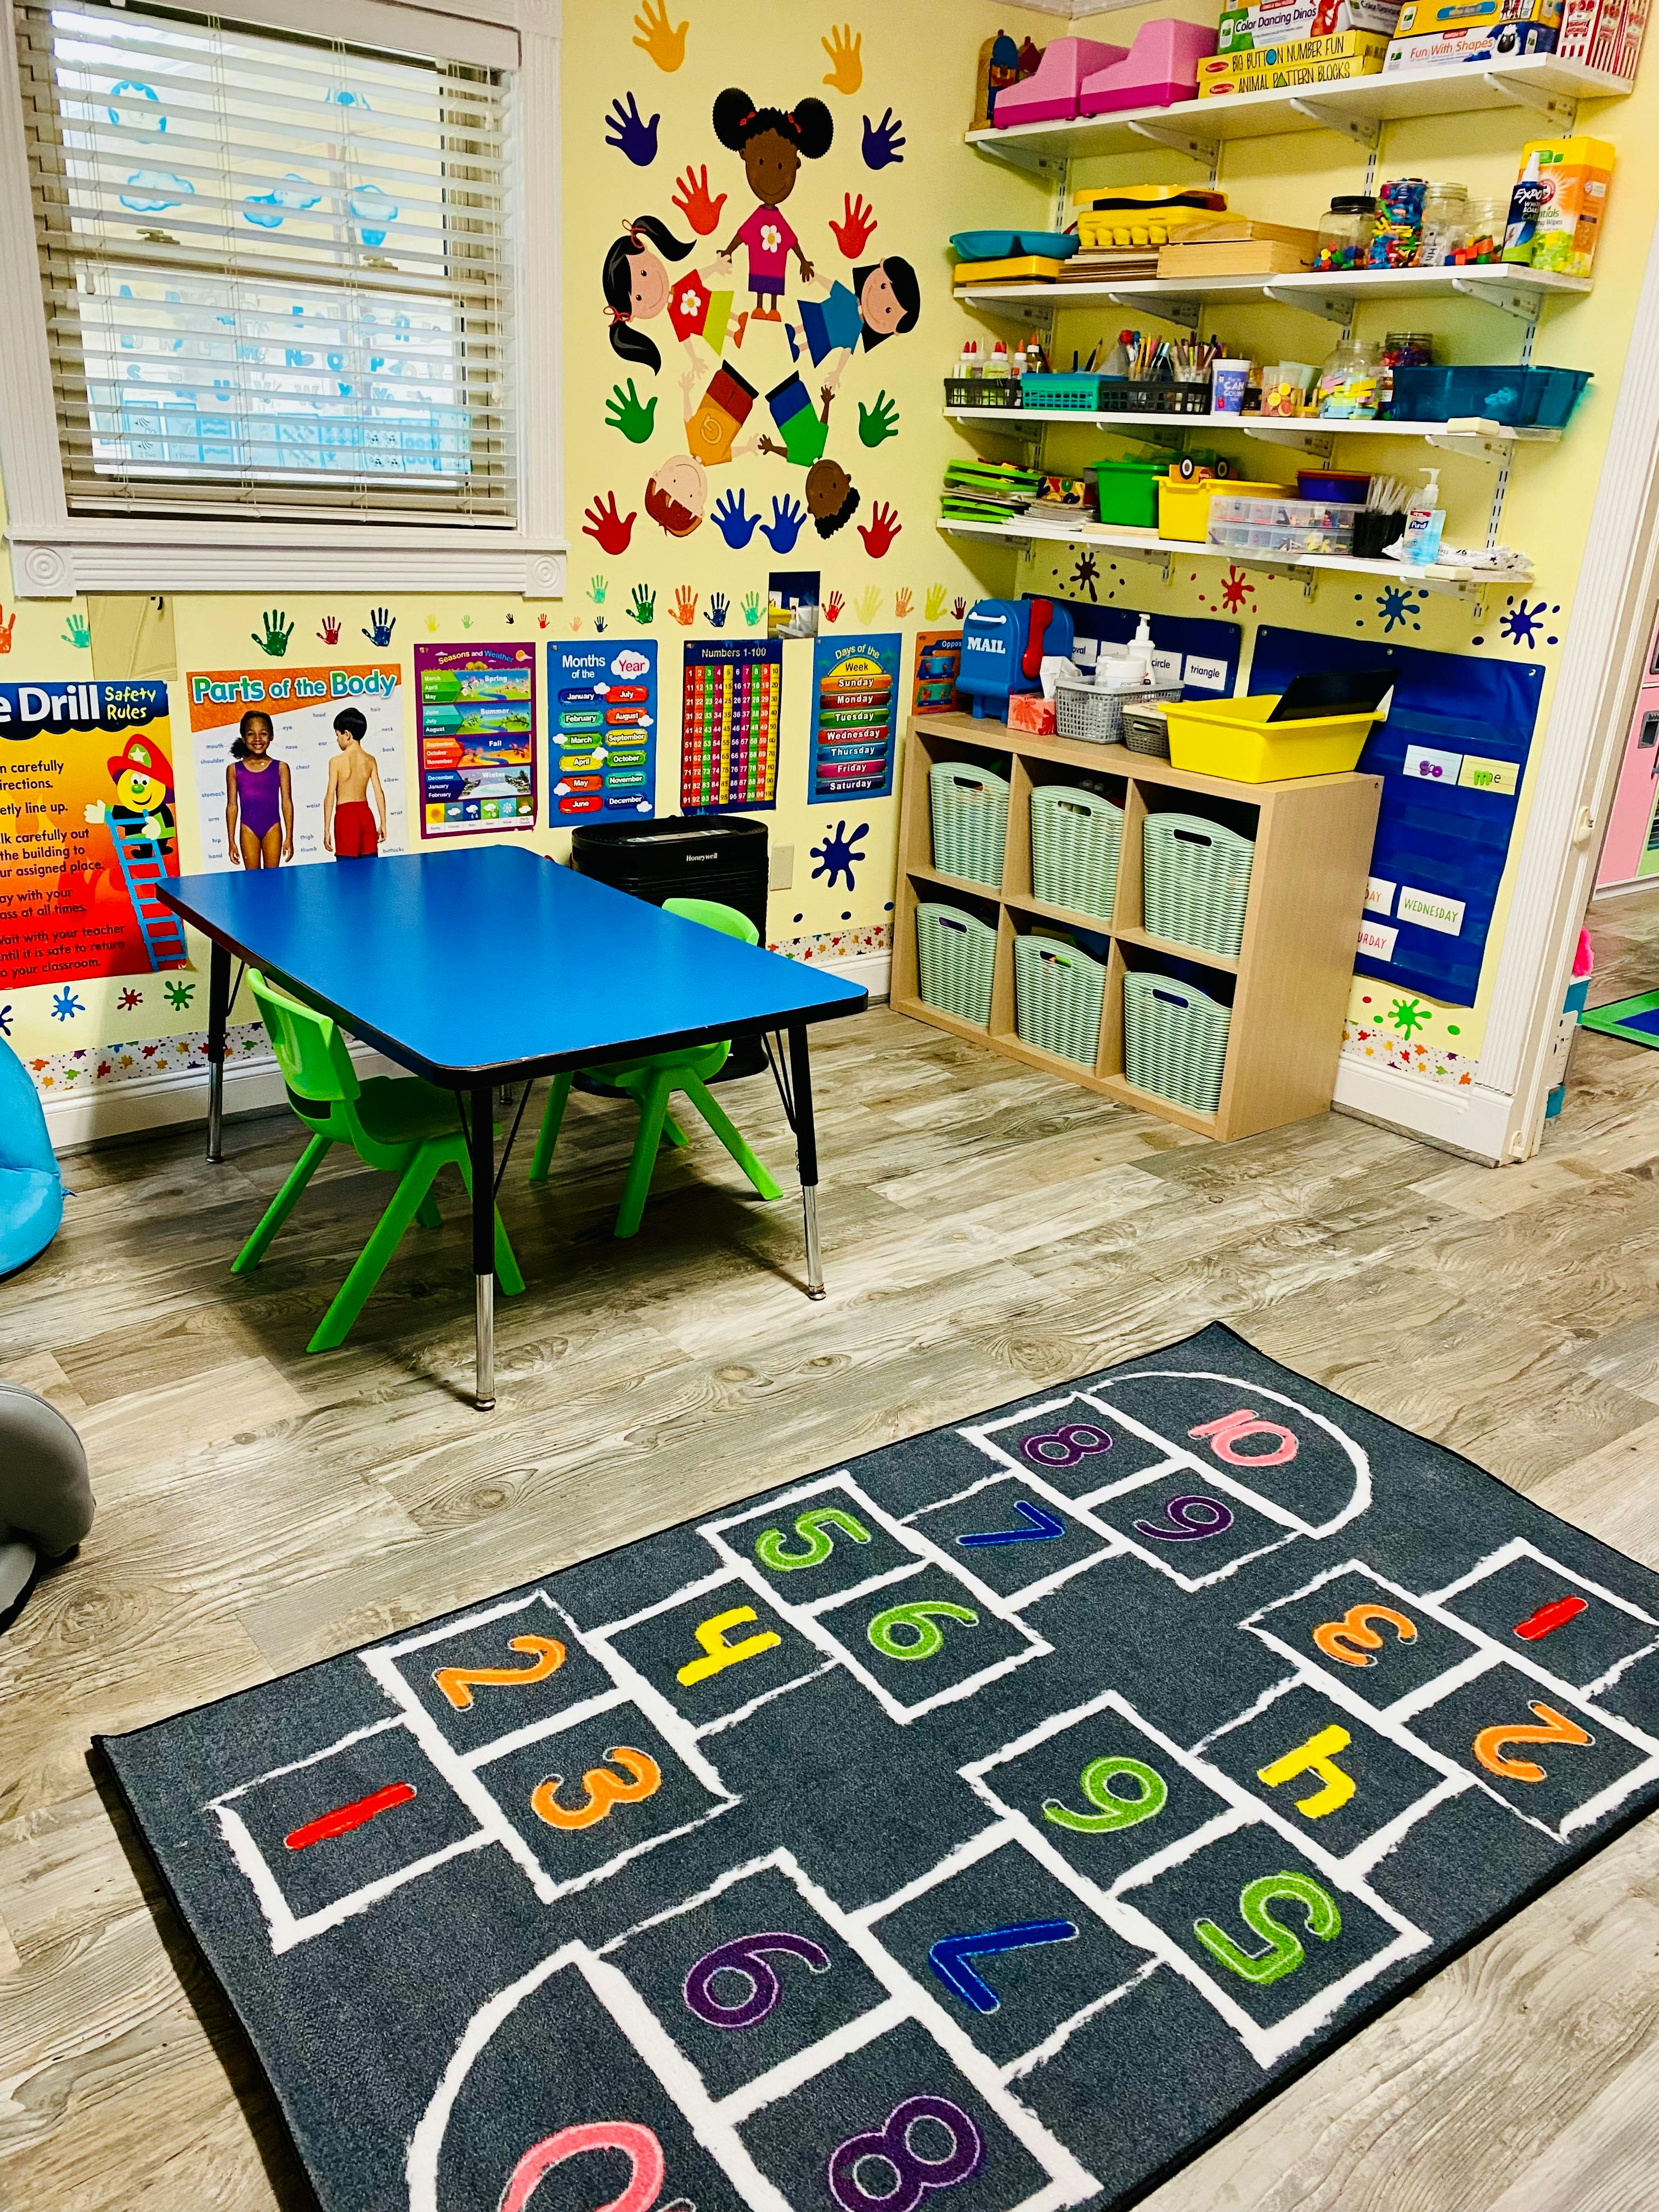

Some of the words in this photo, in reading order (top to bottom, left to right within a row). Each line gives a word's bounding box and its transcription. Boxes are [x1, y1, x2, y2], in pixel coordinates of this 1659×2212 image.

[1236, 20, 1256, 32] Color
[1258, 12, 1291, 27] Dancing
[1293, 7, 1317, 20] Dinos
[1233, 54, 1243, 71] BIG
[1247, 48, 1283, 70] BUTTON
[1287, 40, 1322, 61] NUMBER
[1326, 36, 1344, 58] FUN
[1410, 47, 1427, 59] Fun
[1431, 43, 1453, 55] With
[1455, 37, 1493, 53] Shapes
[1239, 73, 1268, 88] ANIMAL
[1318, 61, 1350, 82] BLOCKS
[1514, 188, 1542, 204] EXPO
[702, 648, 740, 658] Numbers
[743, 648, 766, 657] 1-100
[835, 646, 856, 660] Days
[857, 644, 866, 653] of
[867, 646, 880, 659] the
[967, 636, 1006, 654] MAIL
[1072, 645, 1086, 654] oval
[438, 652, 470, 664] Seasons
[484, 650, 514, 663] Weather
[562, 654, 606, 668] Months
[619, 659, 645, 672] Year
[1152, 658, 1170, 668] circle
[571, 670, 580, 679] of
[582, 669, 595, 678] the
[845, 662, 868, 672] Week
[1191, 665, 1220, 678] triangle
[193, 675, 265, 704] Parts
[268, 678, 290, 698] of
[294, 678, 326, 697] the
[330, 669, 398, 699] Body
[838, 679, 874, 688] Sunday
[18, 684, 100, 721] Drill
[104, 686, 156, 702] Safety
[619, 691, 634, 699] July
[837, 695, 873, 704] Monday
[107, 703, 147, 720] Rules
[835, 712, 874, 722] Tuesday
[827, 729, 880, 741] Wednesday
[831, 746, 875, 757] Thursday
[11, 760, 64, 775] carefully
[837, 764, 867, 773] Friday
[830, 780, 872, 791] Saturday
[25, 802, 46, 814] line
[50, 804, 69, 815] up.
[16, 829, 67, 843] carefully
[71, 828, 89, 839] out
[22, 846, 70, 859] building
[73, 845, 85, 855] to
[686, 853, 718, 861] Honeywell
[16, 861, 66, 878] assigned
[70, 860, 104, 875] place.
[17, 889, 43, 901] with
[46, 889, 72, 902] your
[21, 907, 33, 918] at
[37, 904, 50, 916] all
[54, 904, 87, 914] times.
[1404, 898, 1458, 922] WEDNESDAY
[23, 930, 48, 943] with
[53, 930, 78, 943] your
[82, 923, 125, 936] teacher
[23, 948, 31, 958] it
[35, 947, 43, 957] is
[47, 944, 71, 956] safe
[75, 944, 86, 952] to
[91, 940, 125, 951] return
[12, 965, 37, 979] your
[42, 958, 101, 973] classroom.
[1018, 1422, 1114, 1469] 8
[1187, 1408, 1300, 1468] 10
[955, 1500, 1066, 1548] 7
[755, 1506, 872, 1572] 5
[1512, 1594, 1589, 1641] 1
[867, 1599, 980, 1663] 6
[1313, 1602, 1419, 1668] 3
[674, 1605, 782, 1688] 4
[431, 1633, 567, 1713] 2
[1473, 1697, 1597, 1785] 2
[1256, 1723, 1357, 1821] 4
[529, 1745, 662, 1832] 3
[283, 1781, 417, 1852] 1
[1192, 1870, 1343, 1986] 5
[928, 1918, 1081, 2016] 7
[827, 2095, 984, 2212] 8
